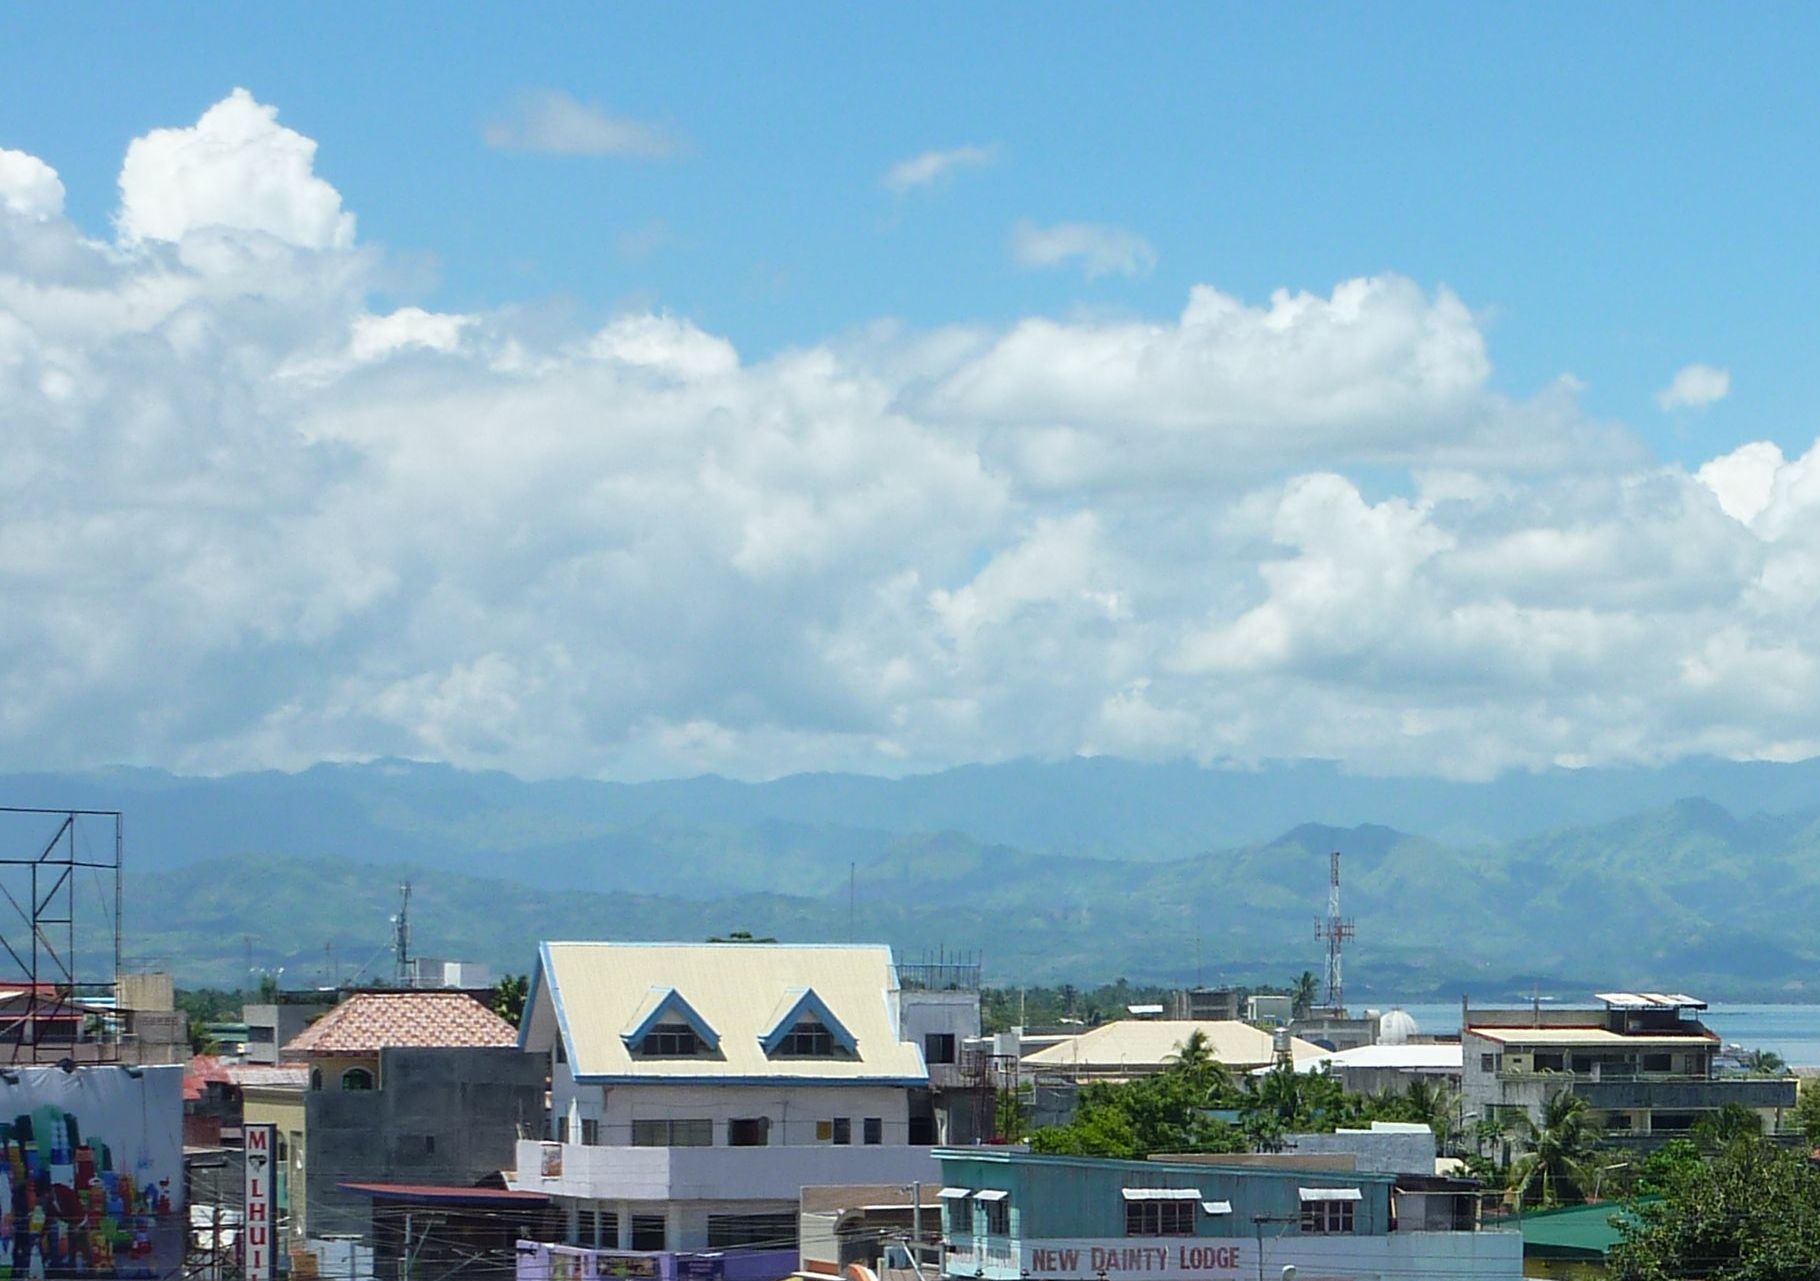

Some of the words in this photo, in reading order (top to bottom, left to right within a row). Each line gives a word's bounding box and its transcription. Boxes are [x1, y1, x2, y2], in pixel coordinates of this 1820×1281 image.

[249, 1131, 267, 1150] M
[1032, 1248, 1080, 1271] NEW
[1091, 1247, 1167, 1272] DAINTY
[1179, 1246, 1240, 1270] LODGE
